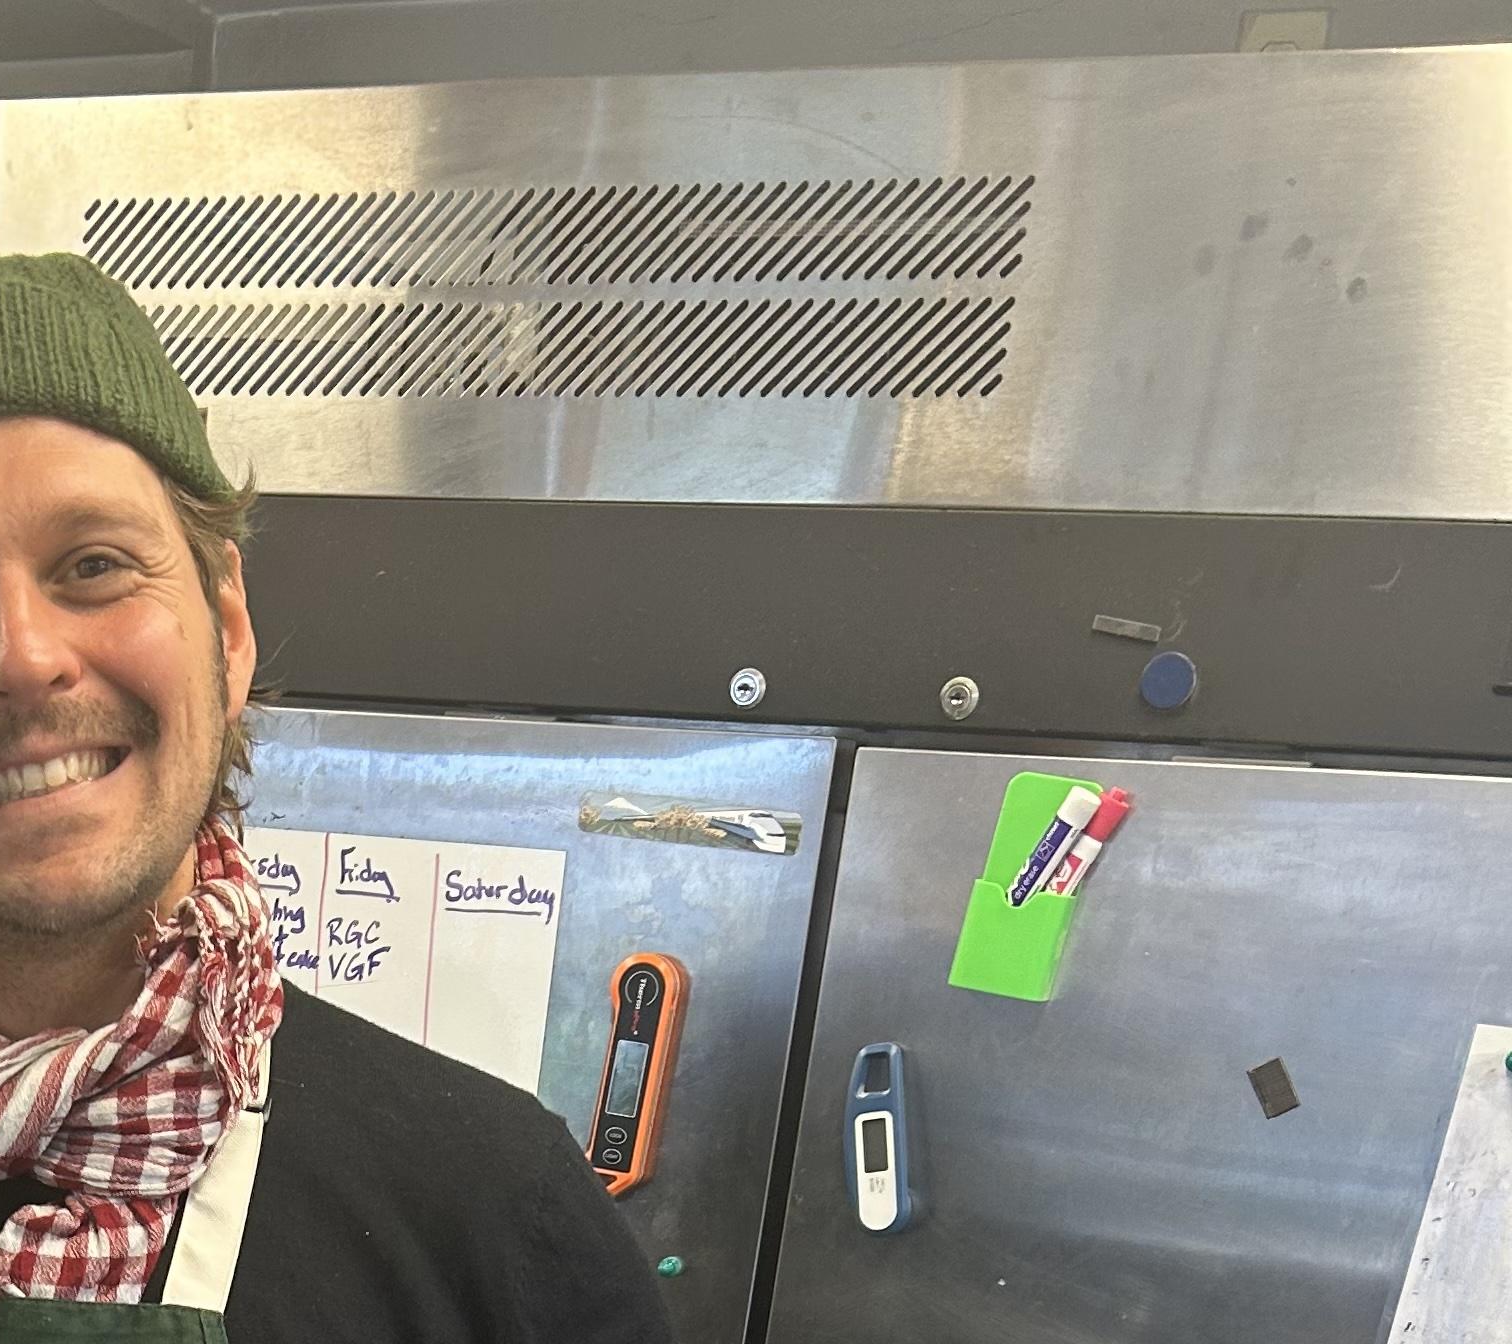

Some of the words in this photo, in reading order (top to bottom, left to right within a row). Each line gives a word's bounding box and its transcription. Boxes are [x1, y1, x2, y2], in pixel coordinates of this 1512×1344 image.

[340, 847, 395, 903] Friday
[445, 870, 556, 925] Saturday
[326, 917, 381, 948] RGC
[329, 946, 392, 982] VGF
